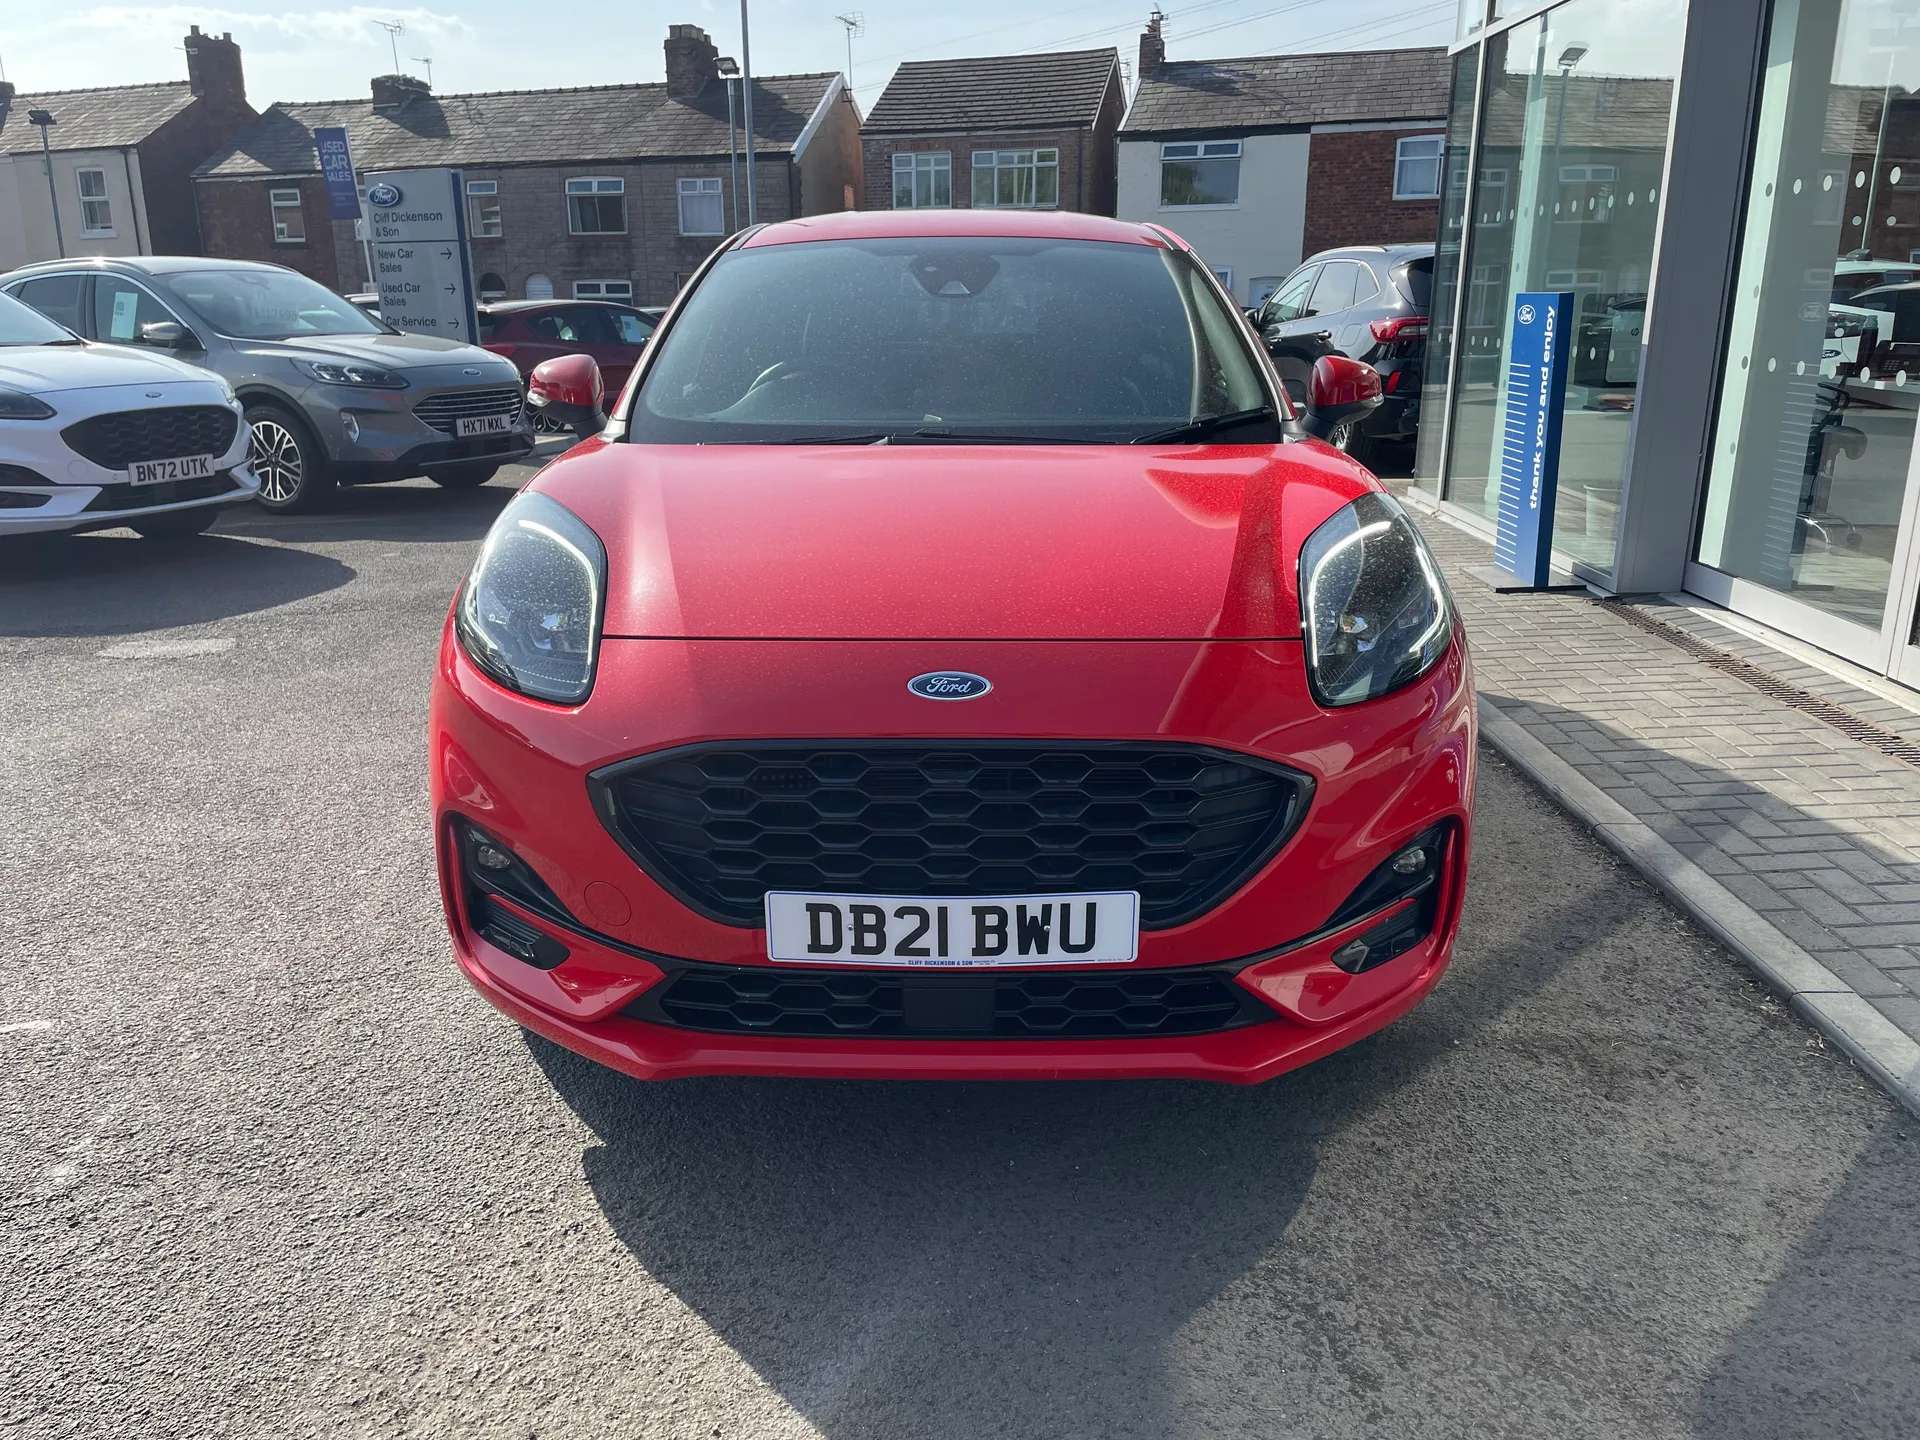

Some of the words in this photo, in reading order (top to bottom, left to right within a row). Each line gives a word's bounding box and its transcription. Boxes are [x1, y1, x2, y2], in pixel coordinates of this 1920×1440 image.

[321, 141, 346, 153] USED
[323, 154, 349, 170] CAR
[374, 212, 389, 223] Cliff
[391, 211, 443, 223] Dickenson
[383, 226, 400, 237] Son
[378, 249, 396, 260] New
[397, 248, 414, 259] Car
[380, 262, 402, 273] Sales
[382, 282, 403, 294] Used
[404, 282, 421, 293] Car
[384, 295, 407, 306] Sales
[386, 315, 400, 326] Car
[401, 315, 437, 327] Service
[1543, 305, 1555, 363] enjoy
[1540, 366, 1549, 407] and
[463, 419, 486, 434] HX71
[487, 417, 506, 431] MXL
[1536, 410, 1545, 448] you
[136, 462, 178, 482] BN72
[180, 457, 209, 477] UTK
[1530, 451, 1542, 510] thank
[926, 677, 972, 693] Ford
[806, 902, 949, 957] DB21
[971, 902, 1097, 956] BWU
